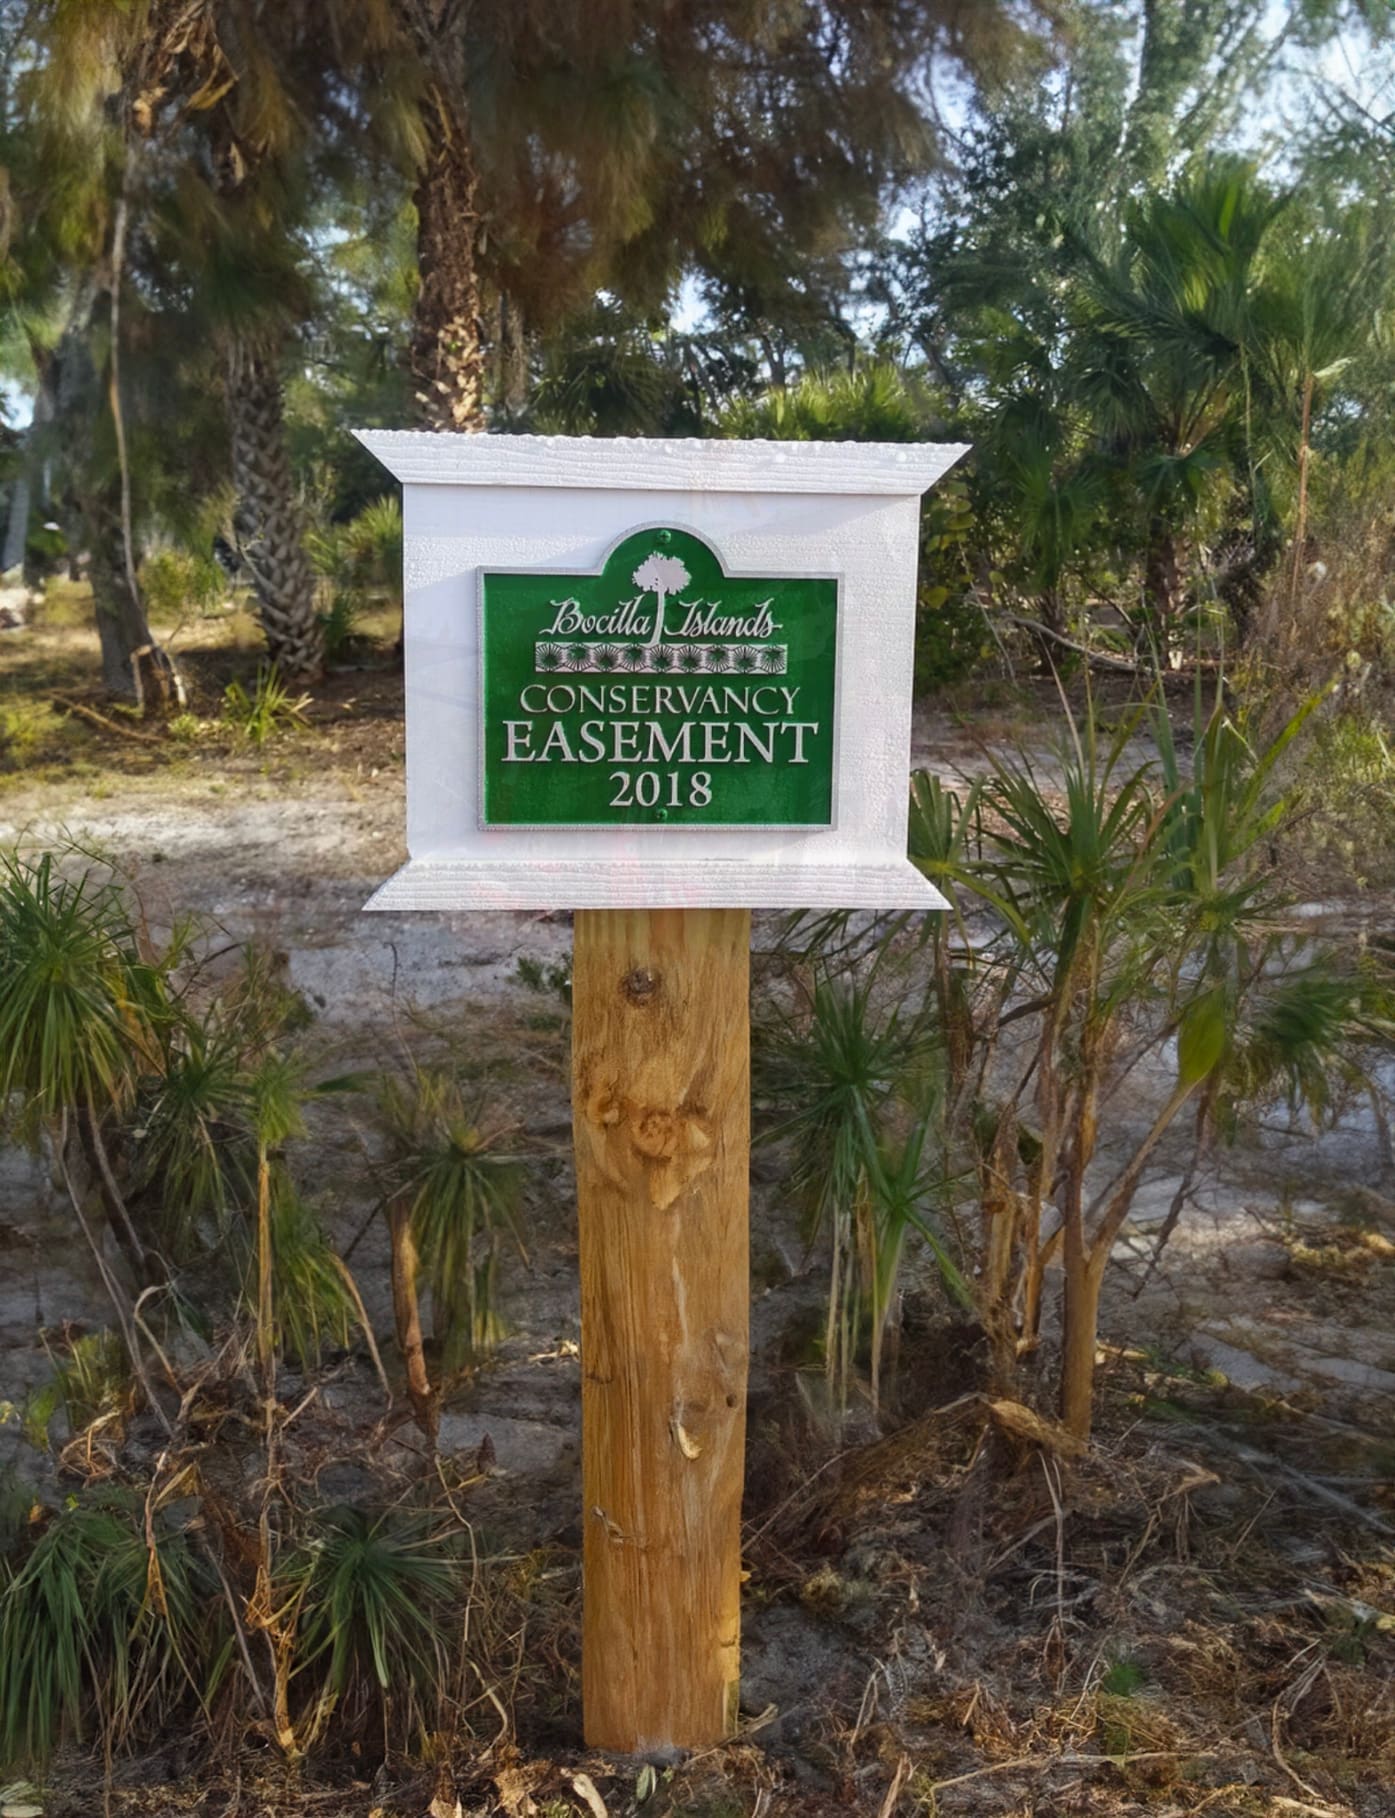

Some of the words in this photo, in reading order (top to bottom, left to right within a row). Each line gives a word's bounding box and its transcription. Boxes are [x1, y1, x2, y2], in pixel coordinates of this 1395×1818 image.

[539, 594, 651, 636] Bocilla
[664, 597, 783, 638] Islands
[520, 684, 801, 715] CONSERVANCY
[501, 720, 819, 764] EASEMENT
[608, 771, 713, 808] 2018
